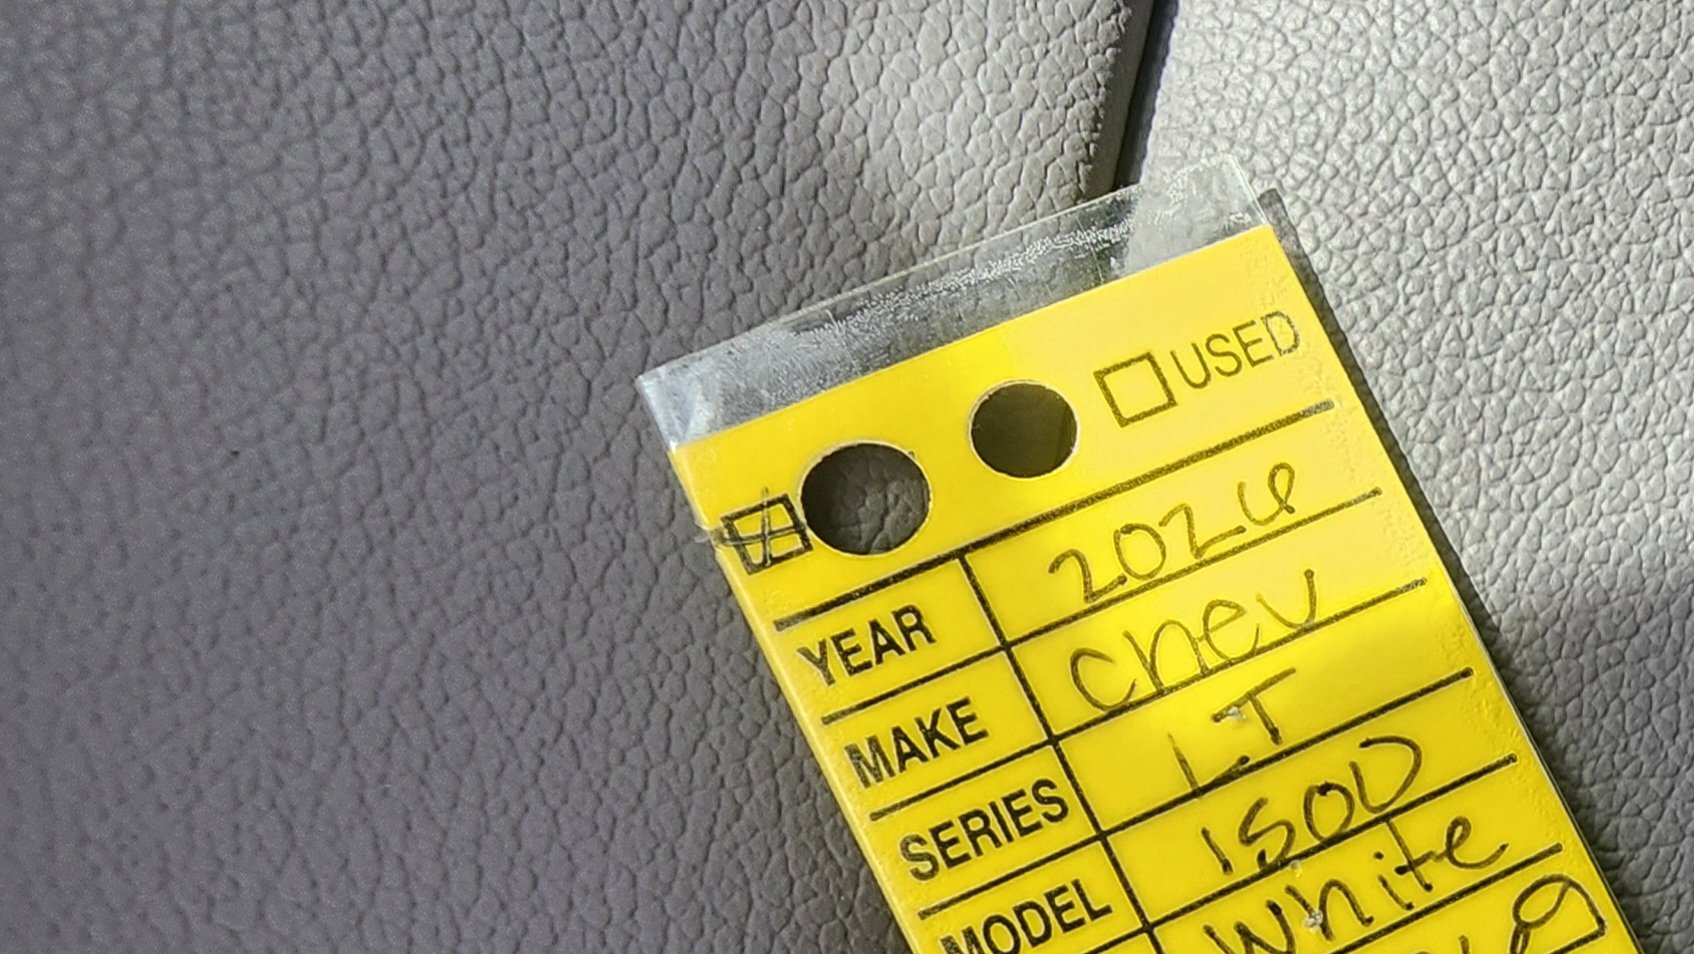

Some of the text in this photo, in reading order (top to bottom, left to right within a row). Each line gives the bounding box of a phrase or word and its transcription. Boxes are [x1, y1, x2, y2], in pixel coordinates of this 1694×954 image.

[1172, 309, 1301, 390] USED
[796, 603, 937, 690] YEAR
[843, 696, 989, 790] MAKE
[1167, 666, 1298, 799] LT
[898, 777, 1071, 882] SERIES
[1200, 734, 1424, 876] 1500
